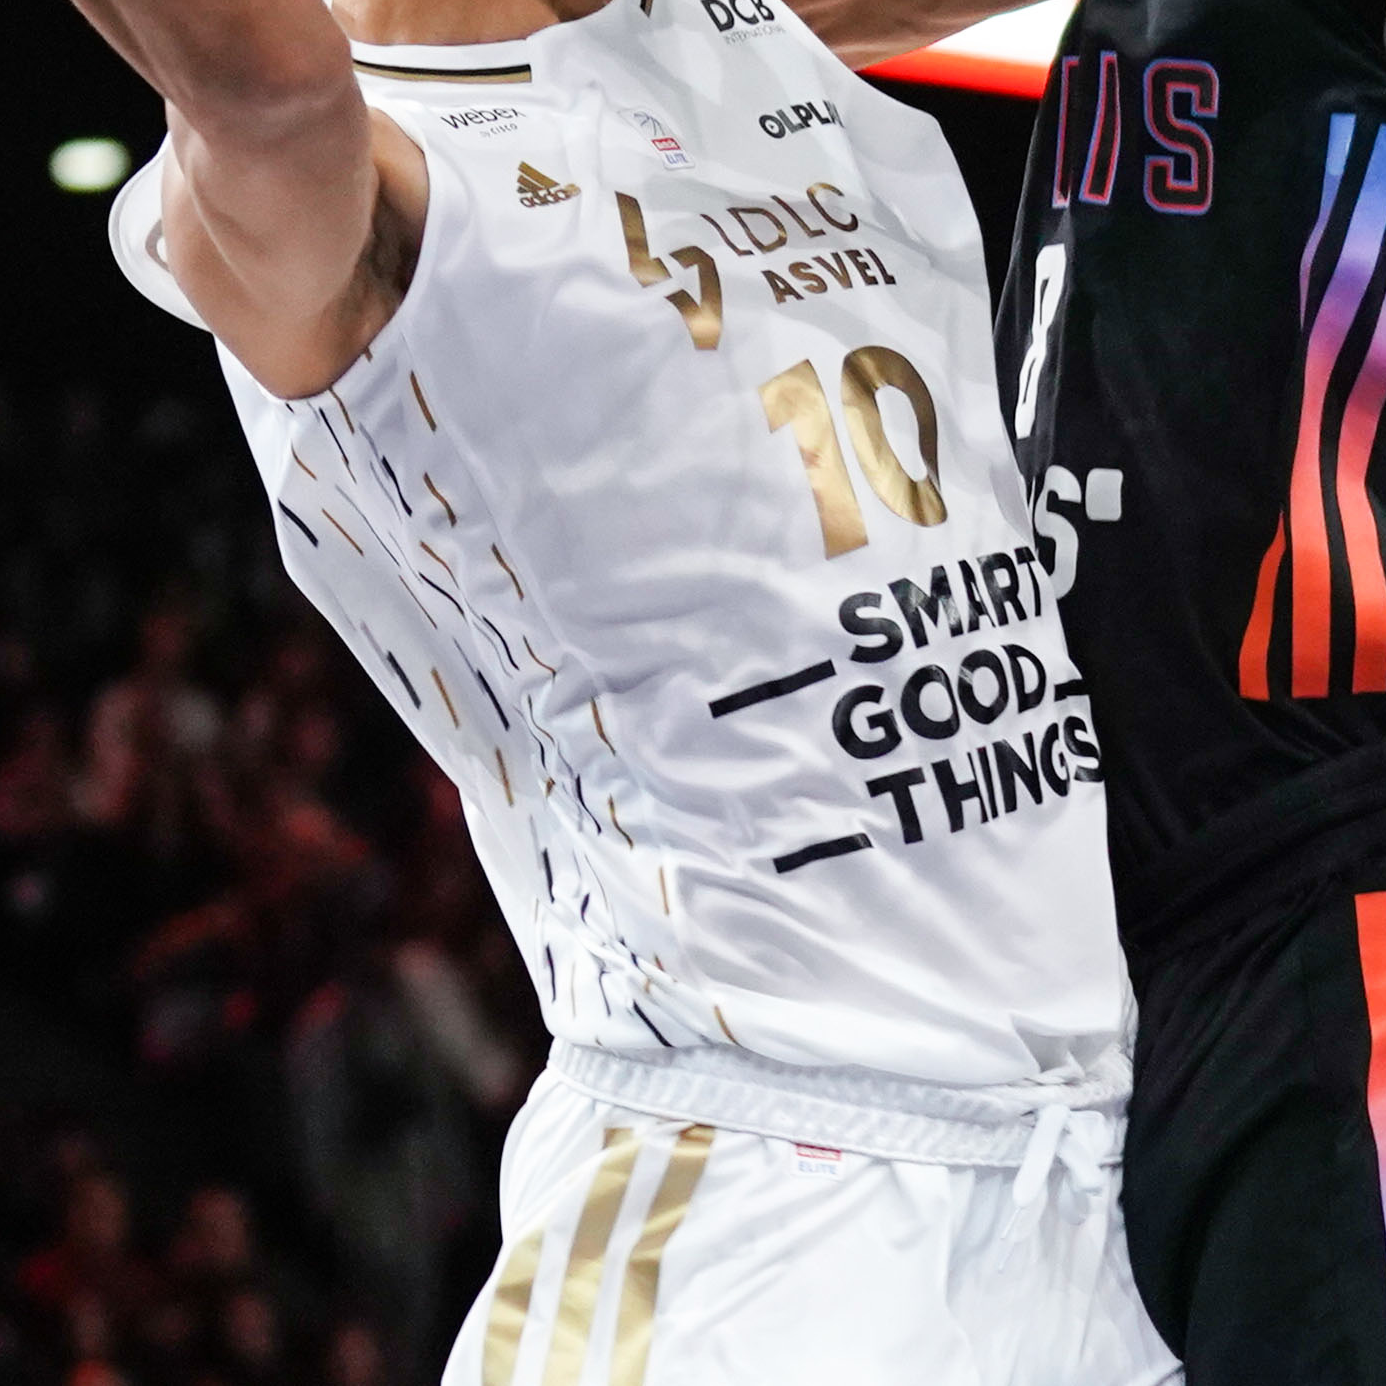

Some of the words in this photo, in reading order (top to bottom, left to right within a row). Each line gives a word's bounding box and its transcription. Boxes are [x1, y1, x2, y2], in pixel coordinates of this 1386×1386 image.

[440, 107, 526, 130] webex
[699, 182, 859, 257] LDLC
[761, 247, 897, 305] ASVEL
[758, 345, 948, 559] 10
[838, 545, 1044, 664] SMART
[831, 643, 1047, 760] GOOD
[865, 715, 1105, 845] THINGS
